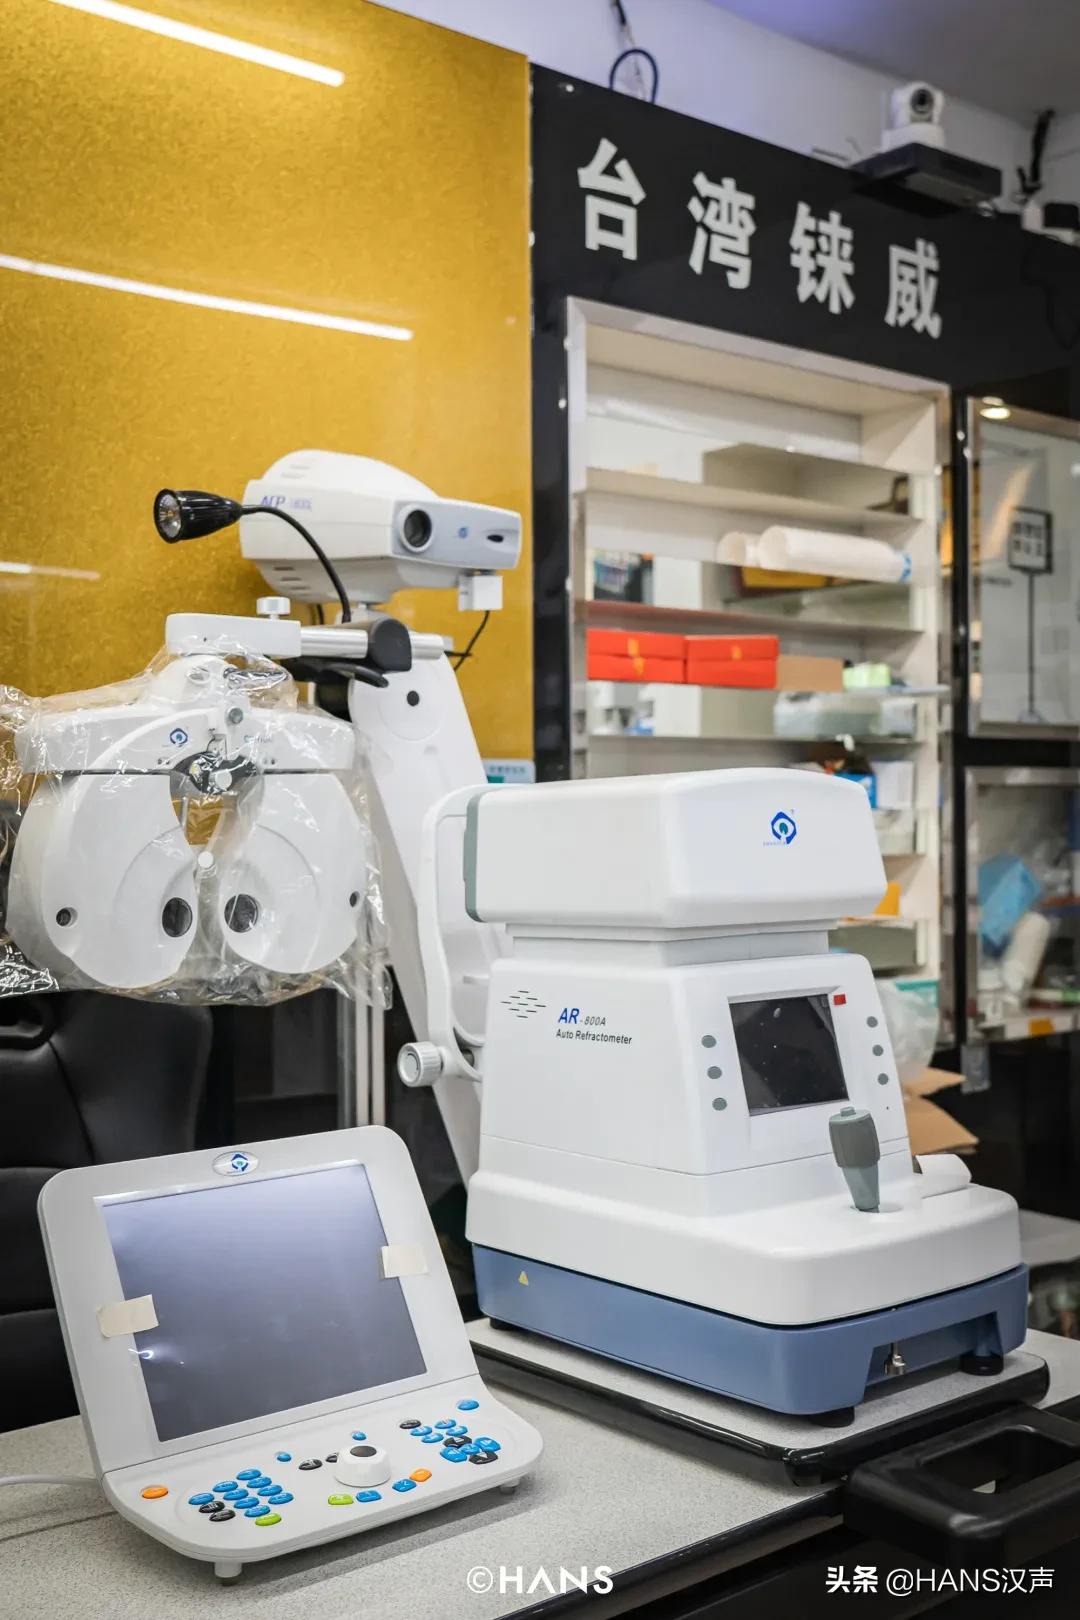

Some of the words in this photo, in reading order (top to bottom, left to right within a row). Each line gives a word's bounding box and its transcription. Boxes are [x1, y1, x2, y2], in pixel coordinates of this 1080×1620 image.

[577, 137, 942, 339] 台湾铼威
[556, 1028, 574, 1039] Auto
[575, 1030, 632, 1045] Refractometer
